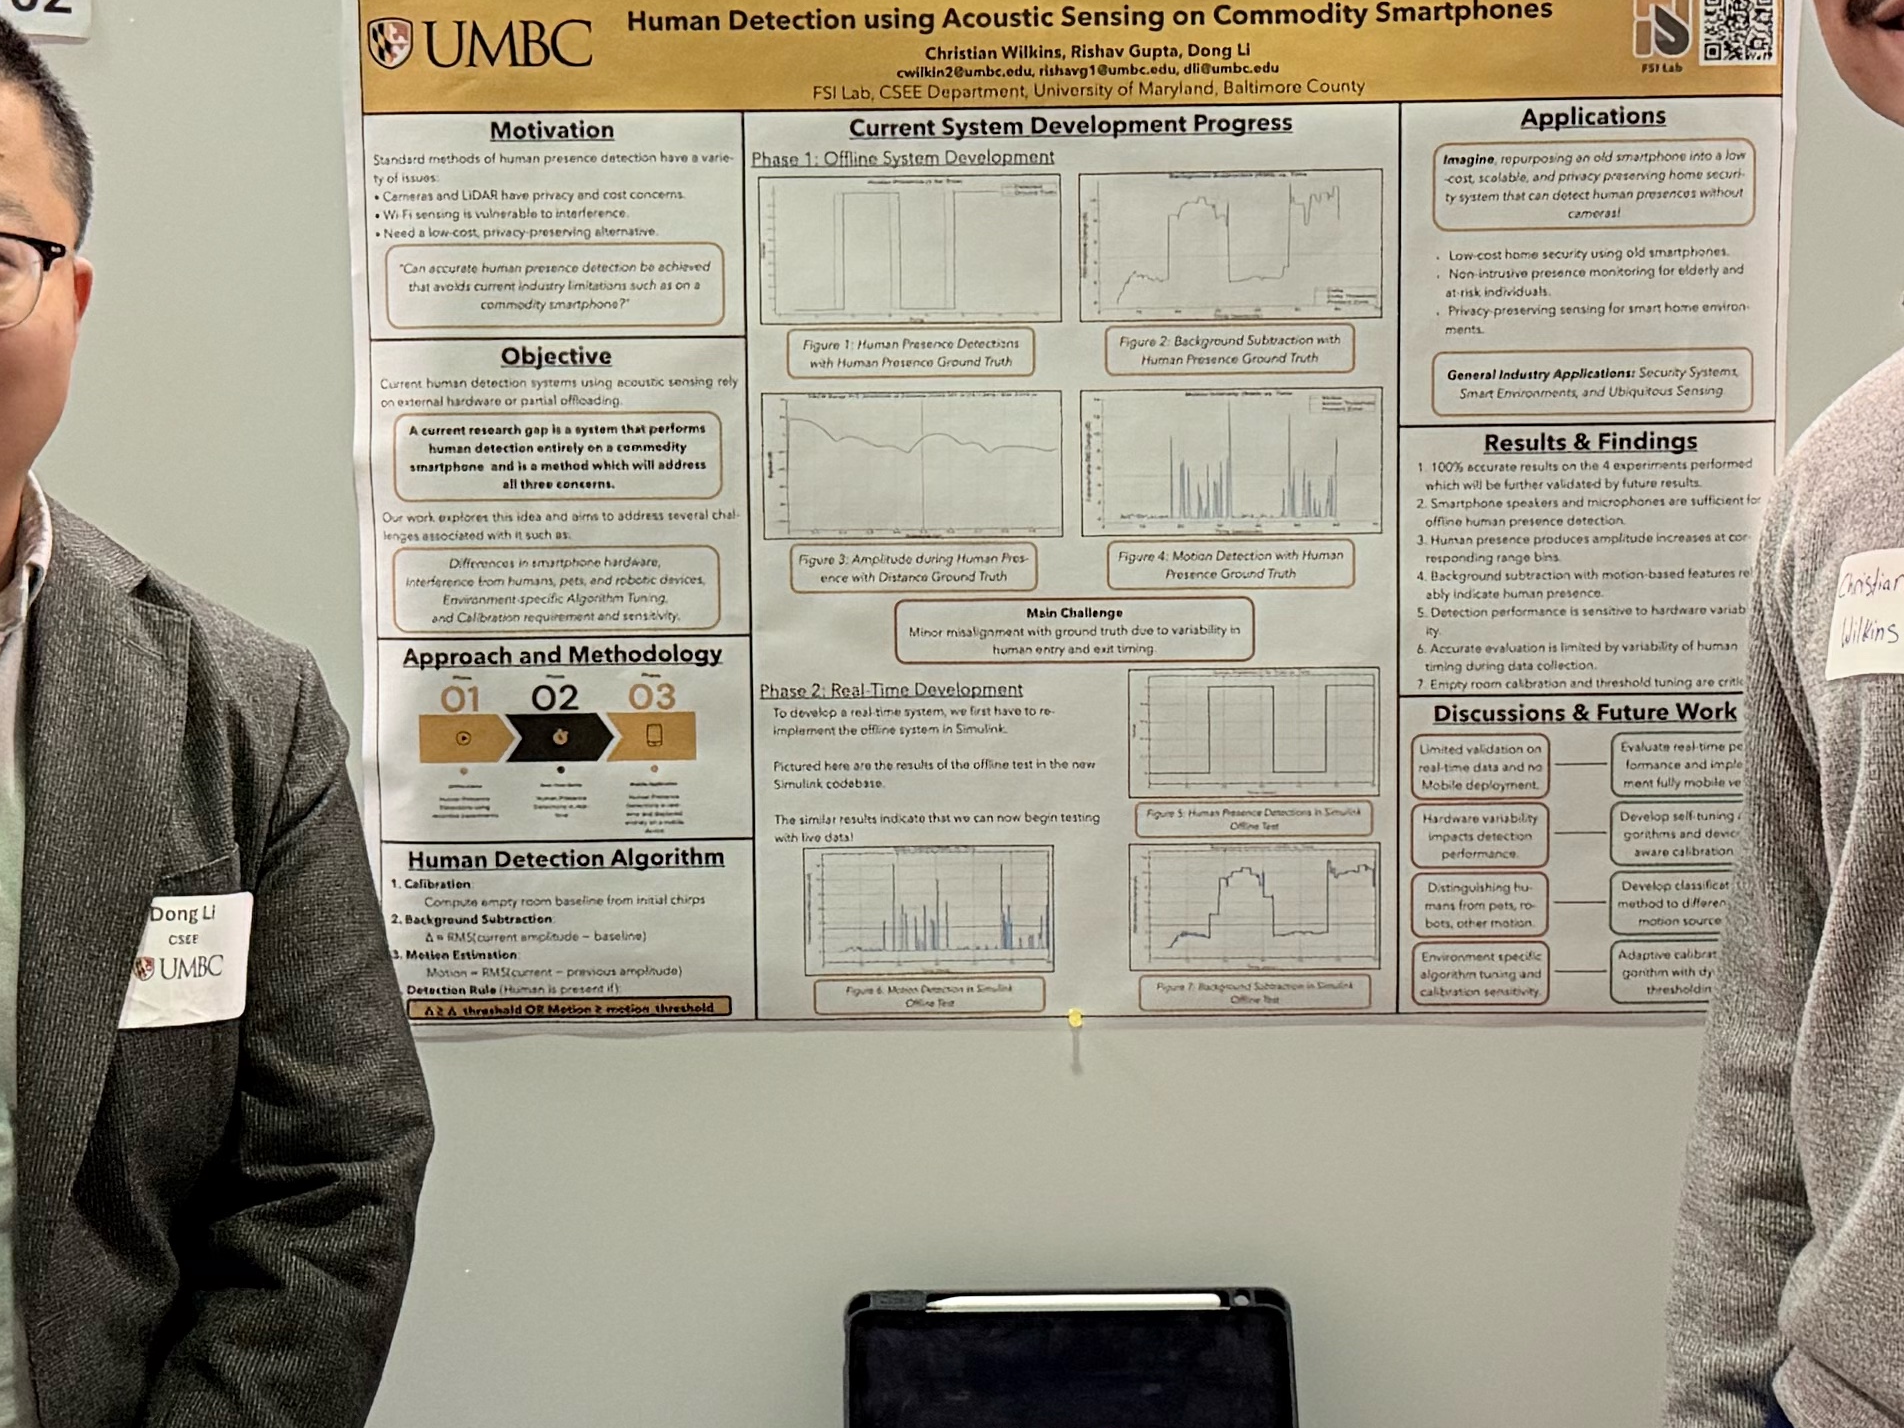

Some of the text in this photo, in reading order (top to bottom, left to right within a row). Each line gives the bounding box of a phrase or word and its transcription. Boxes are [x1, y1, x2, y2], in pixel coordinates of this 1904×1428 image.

[628, 10, 720, 32] Human
[729, 8, 856, 31] Detection
[865, 7, 934, 35] using
[942, 5, 1053, 28] Acoustic
[1061, 4, 1164, 32] Sensing
[1173, 10, 1204, 26] on
[1214, 1, 1368, 30] Commodity
[422, 19, 593, 68] UMBC
[925, 43, 1250, 62] Christian Wilkins, Rishav Gupta, Dong Li
[897, 61, 1279, 80] cwilkin2@umbc.edu, rishavg1@umbc.edu, dli@umbc.edu
[813, 78, 1365, 103] FSI Lab, CSEE Department, University of Maryland, Baltimore County
[850, 113, 1292, 142] Current System Development Progress
[1521, 105, 1666, 129] Applications
[491, 120, 613, 139] Motivation
[752, 149, 1054, 169] Phase 1: Offline System Development
[502, 345, 611, 369] Objective
[1485, 431, 1697, 454] Results & Findings
[1027, 607, 1122, 621] Main Challenge
[403, 643, 722, 668] Approach and Methodology
[441, 684, 478, 713] 01
[532, 684, 579, 711] 02
[628, 683, 675, 710] 03
[761, 682, 1023, 700] Phase 2: Real-Time Development
[1434, 701, 1736, 721] Discussions & Future Work
[409, 848, 724, 871] Human Detection Algorithm
[150, 904, 215, 924] Dong Li
[159, 954, 223, 980] UMBC
